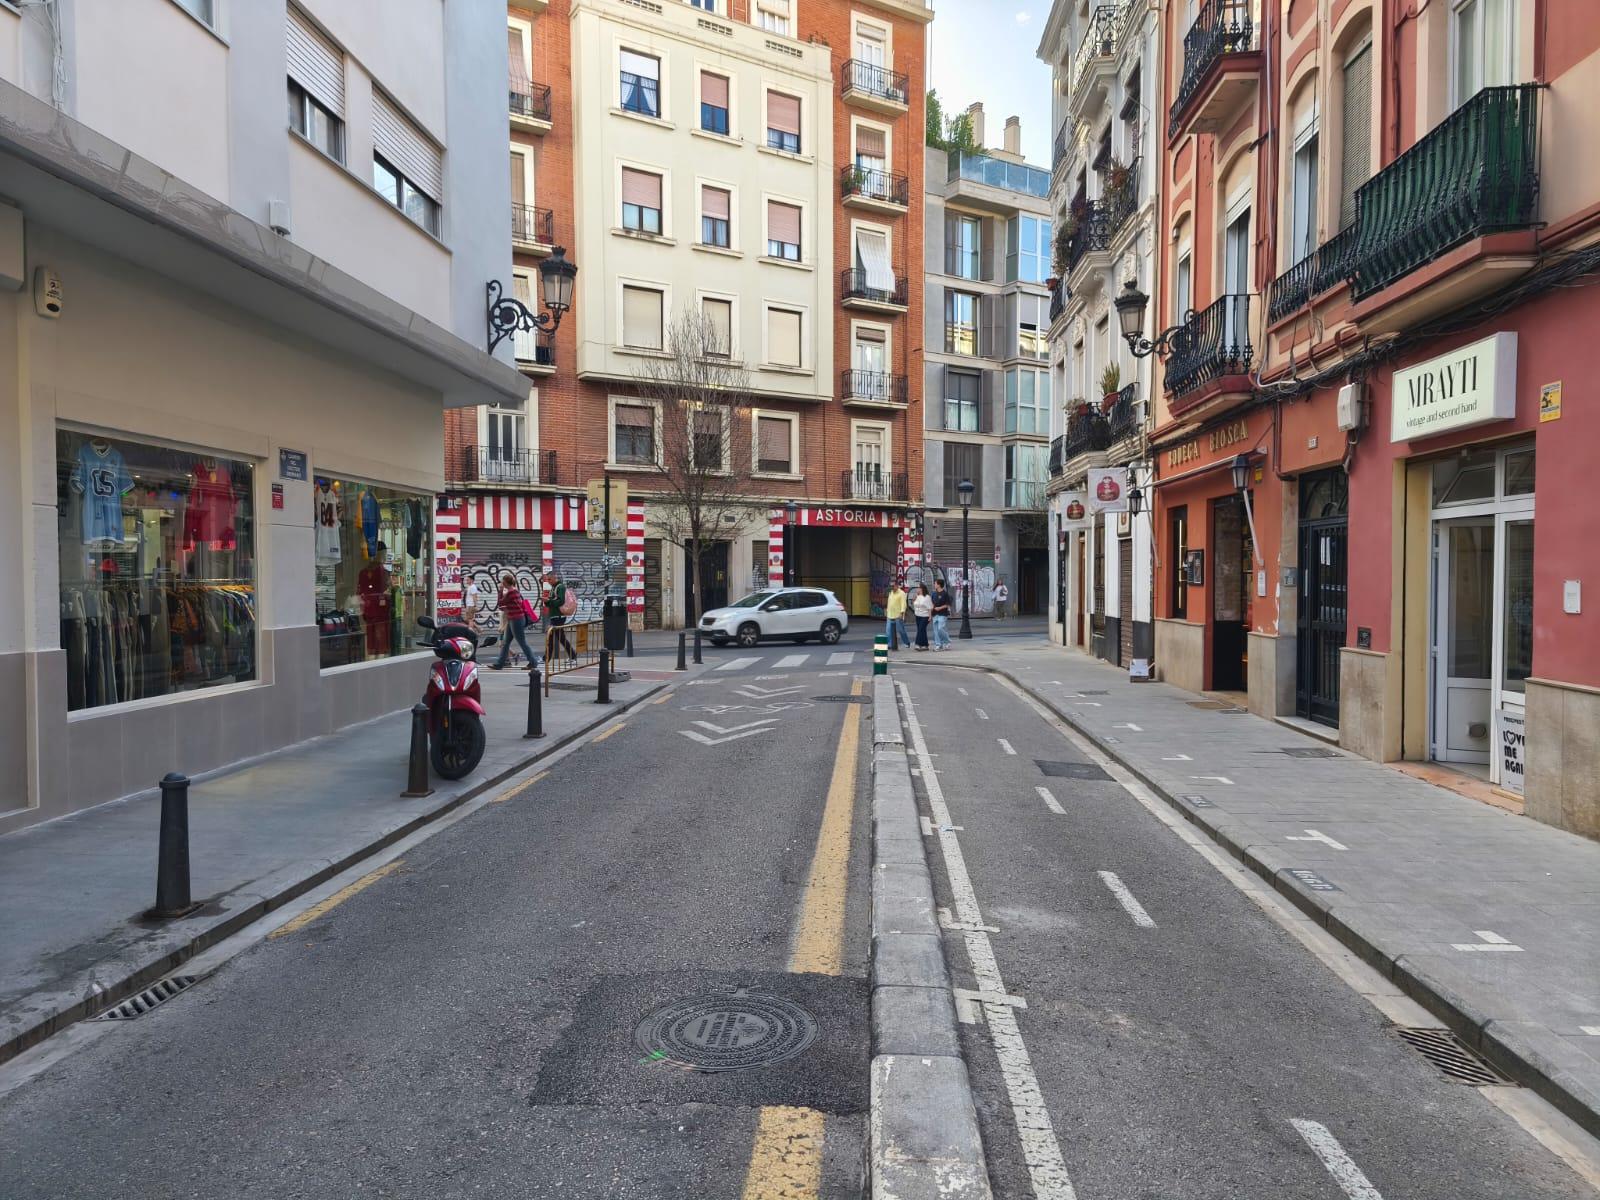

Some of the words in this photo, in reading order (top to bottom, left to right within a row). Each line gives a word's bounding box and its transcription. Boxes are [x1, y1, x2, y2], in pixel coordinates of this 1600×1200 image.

[1408, 355, 1480, 410] MRAYTI
[1406, 415, 1426, 428] vintage
[1426, 411, 1438, 423] and
[1438, 406, 1460, 419] second
[1460, 400, 1477, 413] hand
[815, 508, 876, 523] ASTORIA
[897, 532, 905, 588] GARAG
[1504, 746, 1517, 759] ME
[1505, 759, 1524, 775] AGAI
